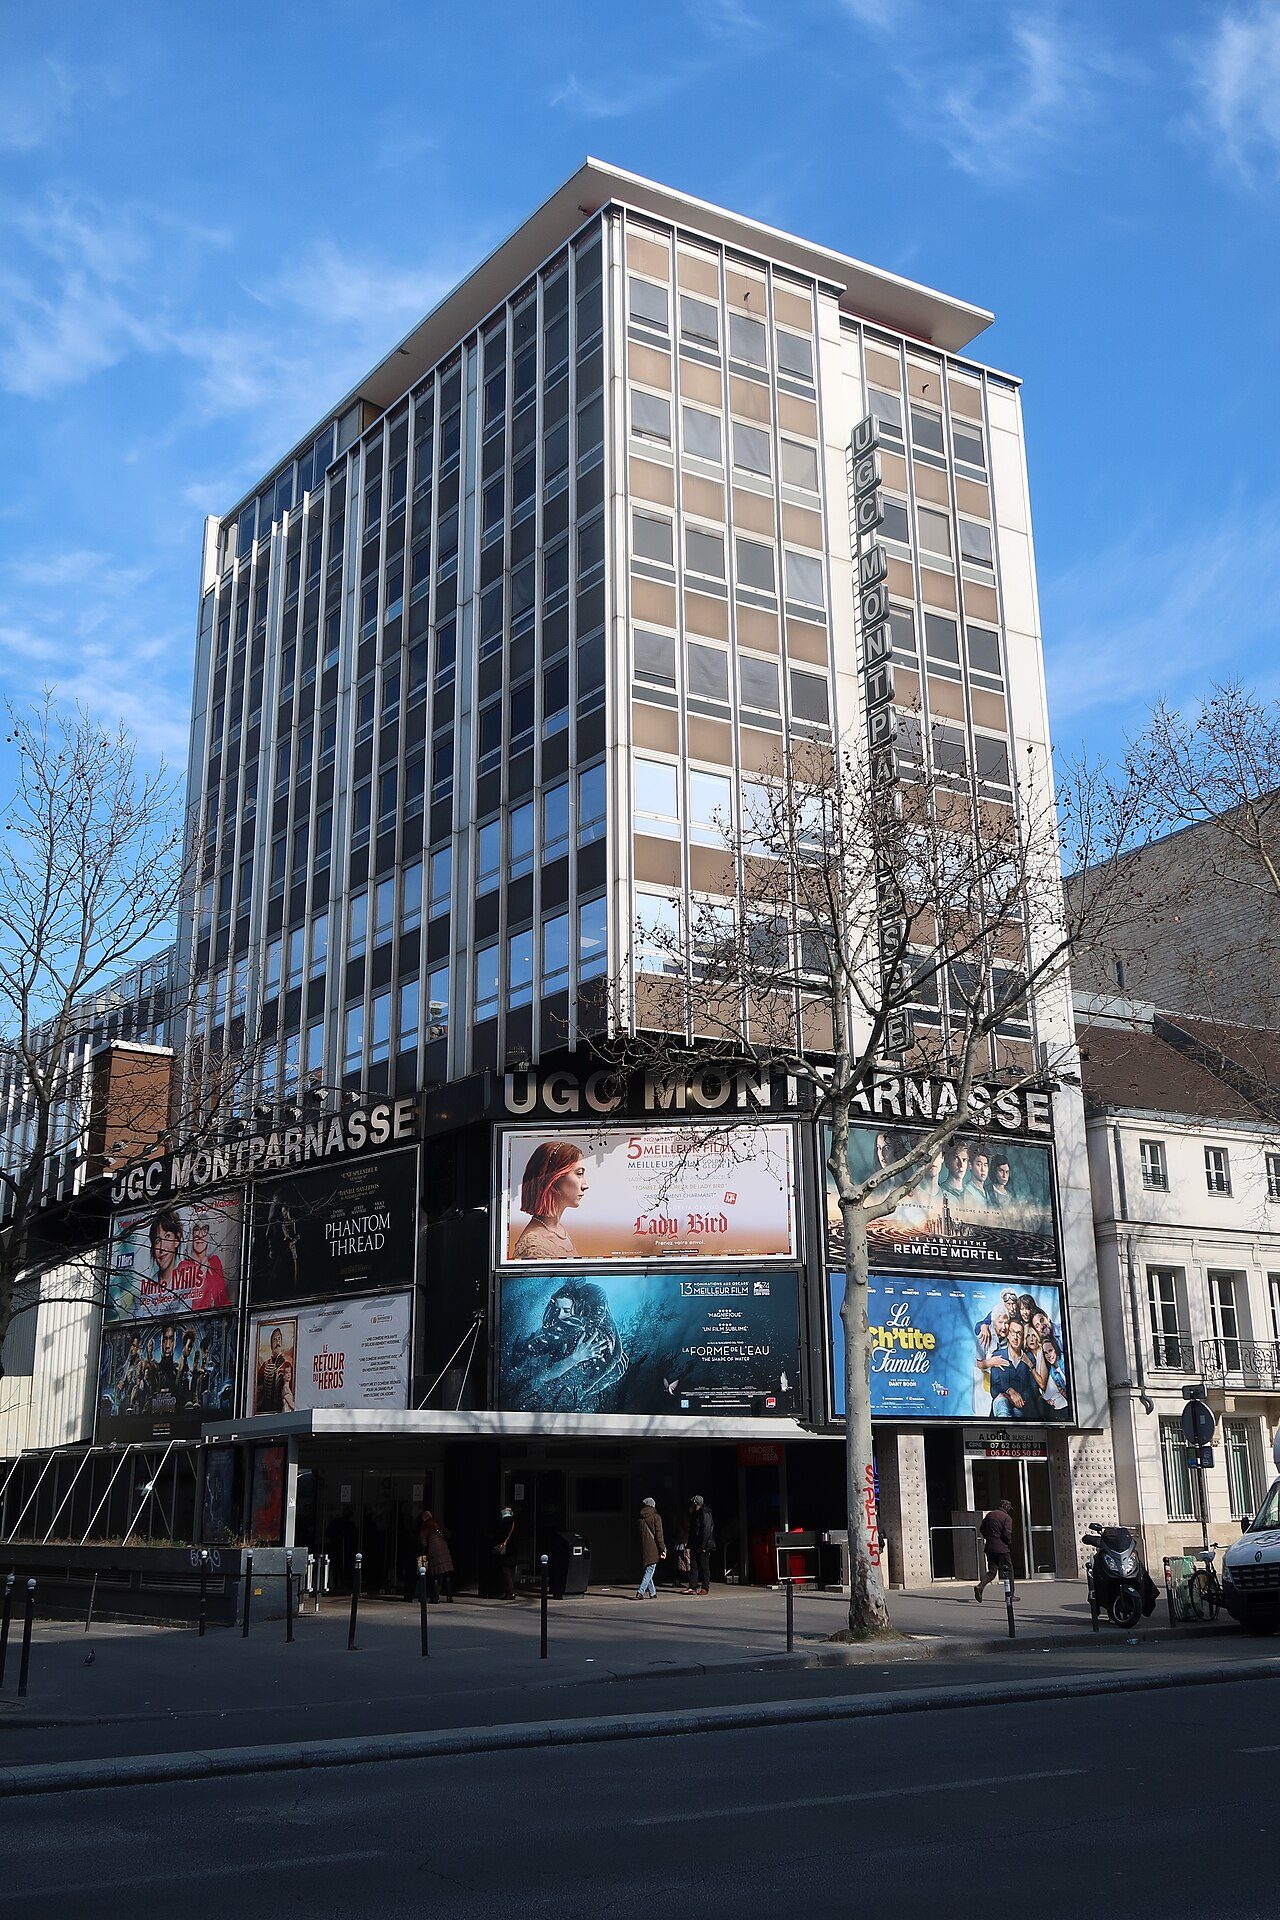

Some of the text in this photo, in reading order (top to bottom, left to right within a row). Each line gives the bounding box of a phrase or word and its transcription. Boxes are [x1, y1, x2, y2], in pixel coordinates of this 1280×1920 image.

[855, 426, 875, 519] UGC
[861, 552, 906, 1050] MONTPAASSE
[504, 1070, 621, 1115] UGC
[111, 1098, 416, 1204] UGC MONTPARNASSE
[627, 1137, 643, 1160] 5
[643, 1143, 730, 1155] MEILLEUR FILM
[627, 1161, 674, 1169] MEILLEUR
[325, 1212, 390, 1239] PHANTOM
[633, 1212, 728, 1239] Lady Bird
[329, 1233, 385, 1256] THREAD
[894, 1243, 948, 1257] REMÈDE
[950, 1248, 1002, 1261] MORTEL
[926, 1237, 987, 1247] LABYRINTHE
[141, 1266, 204, 1295] Mme Mills
[680, 1282, 693, 1295] 13
[693, 1286, 749, 1295] MEILLEUR FILM
[886, 1302, 911, 1327] La
[322, 1344, 328, 1353] LE
[690, 1346, 730, 1356] FORME
[739, 1345, 770, 1356] L'EAU
[871, 1346, 930, 1374] Famille
[313, 1353, 345, 1372] RETOUR
[313, 1373, 319, 1382] DU
